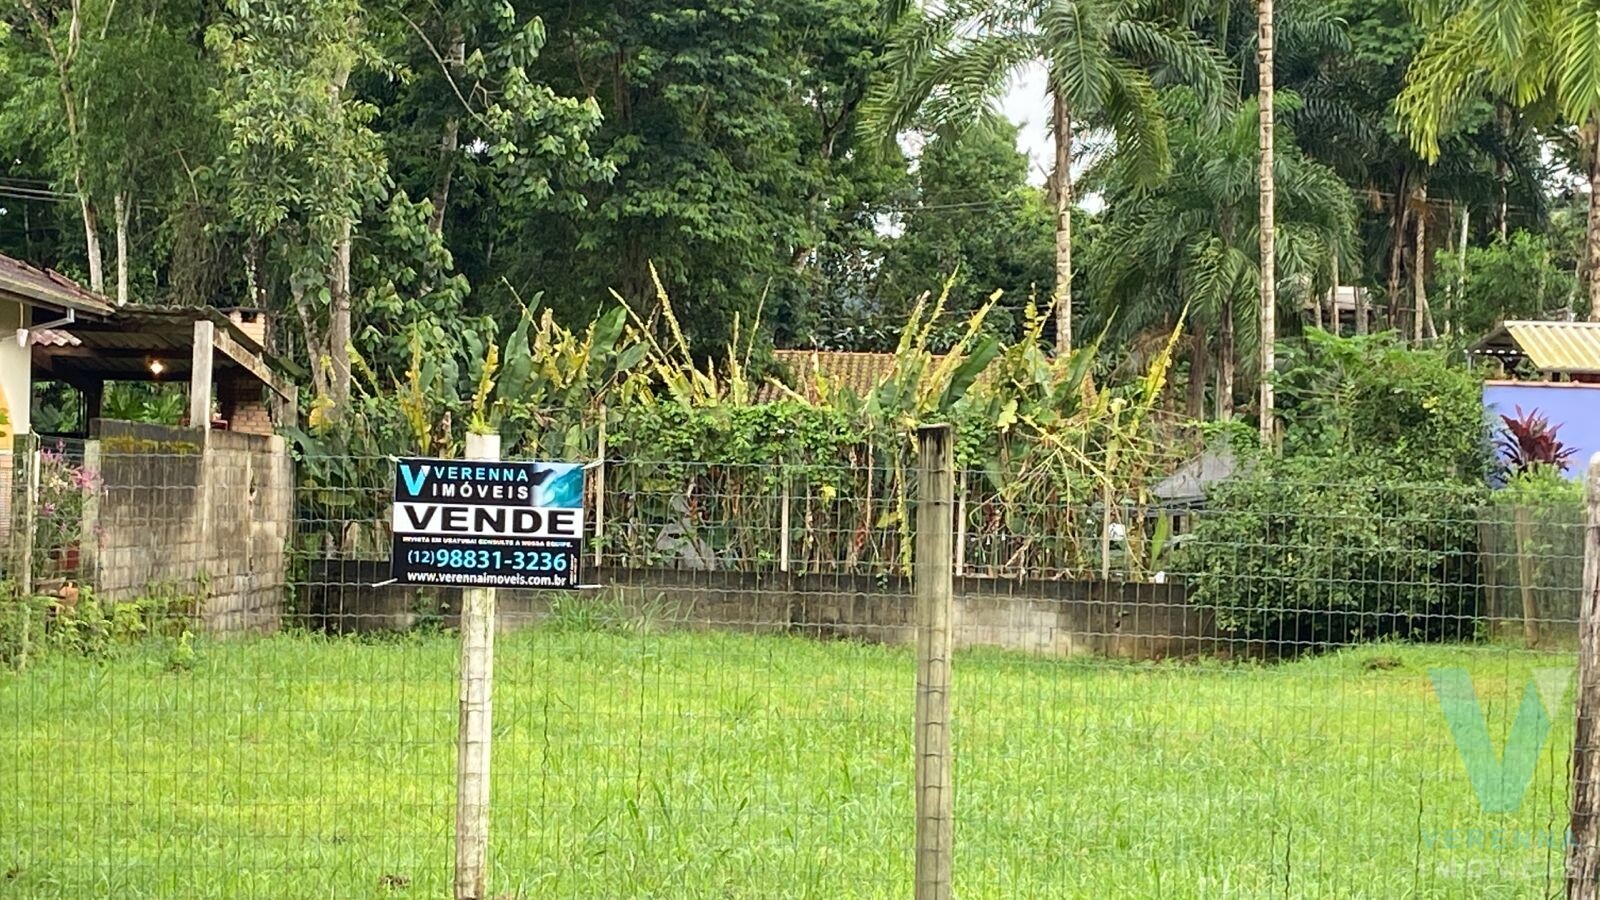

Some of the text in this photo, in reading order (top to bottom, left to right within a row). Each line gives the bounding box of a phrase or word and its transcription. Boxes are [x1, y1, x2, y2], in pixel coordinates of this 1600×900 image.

[433, 466, 529, 482] VERENNA
[432, 479, 529, 499] IMÓVEIS
[403, 505, 575, 535] VENDE
[407, 571, 567, 586] www.verennaimoveis.com.br
